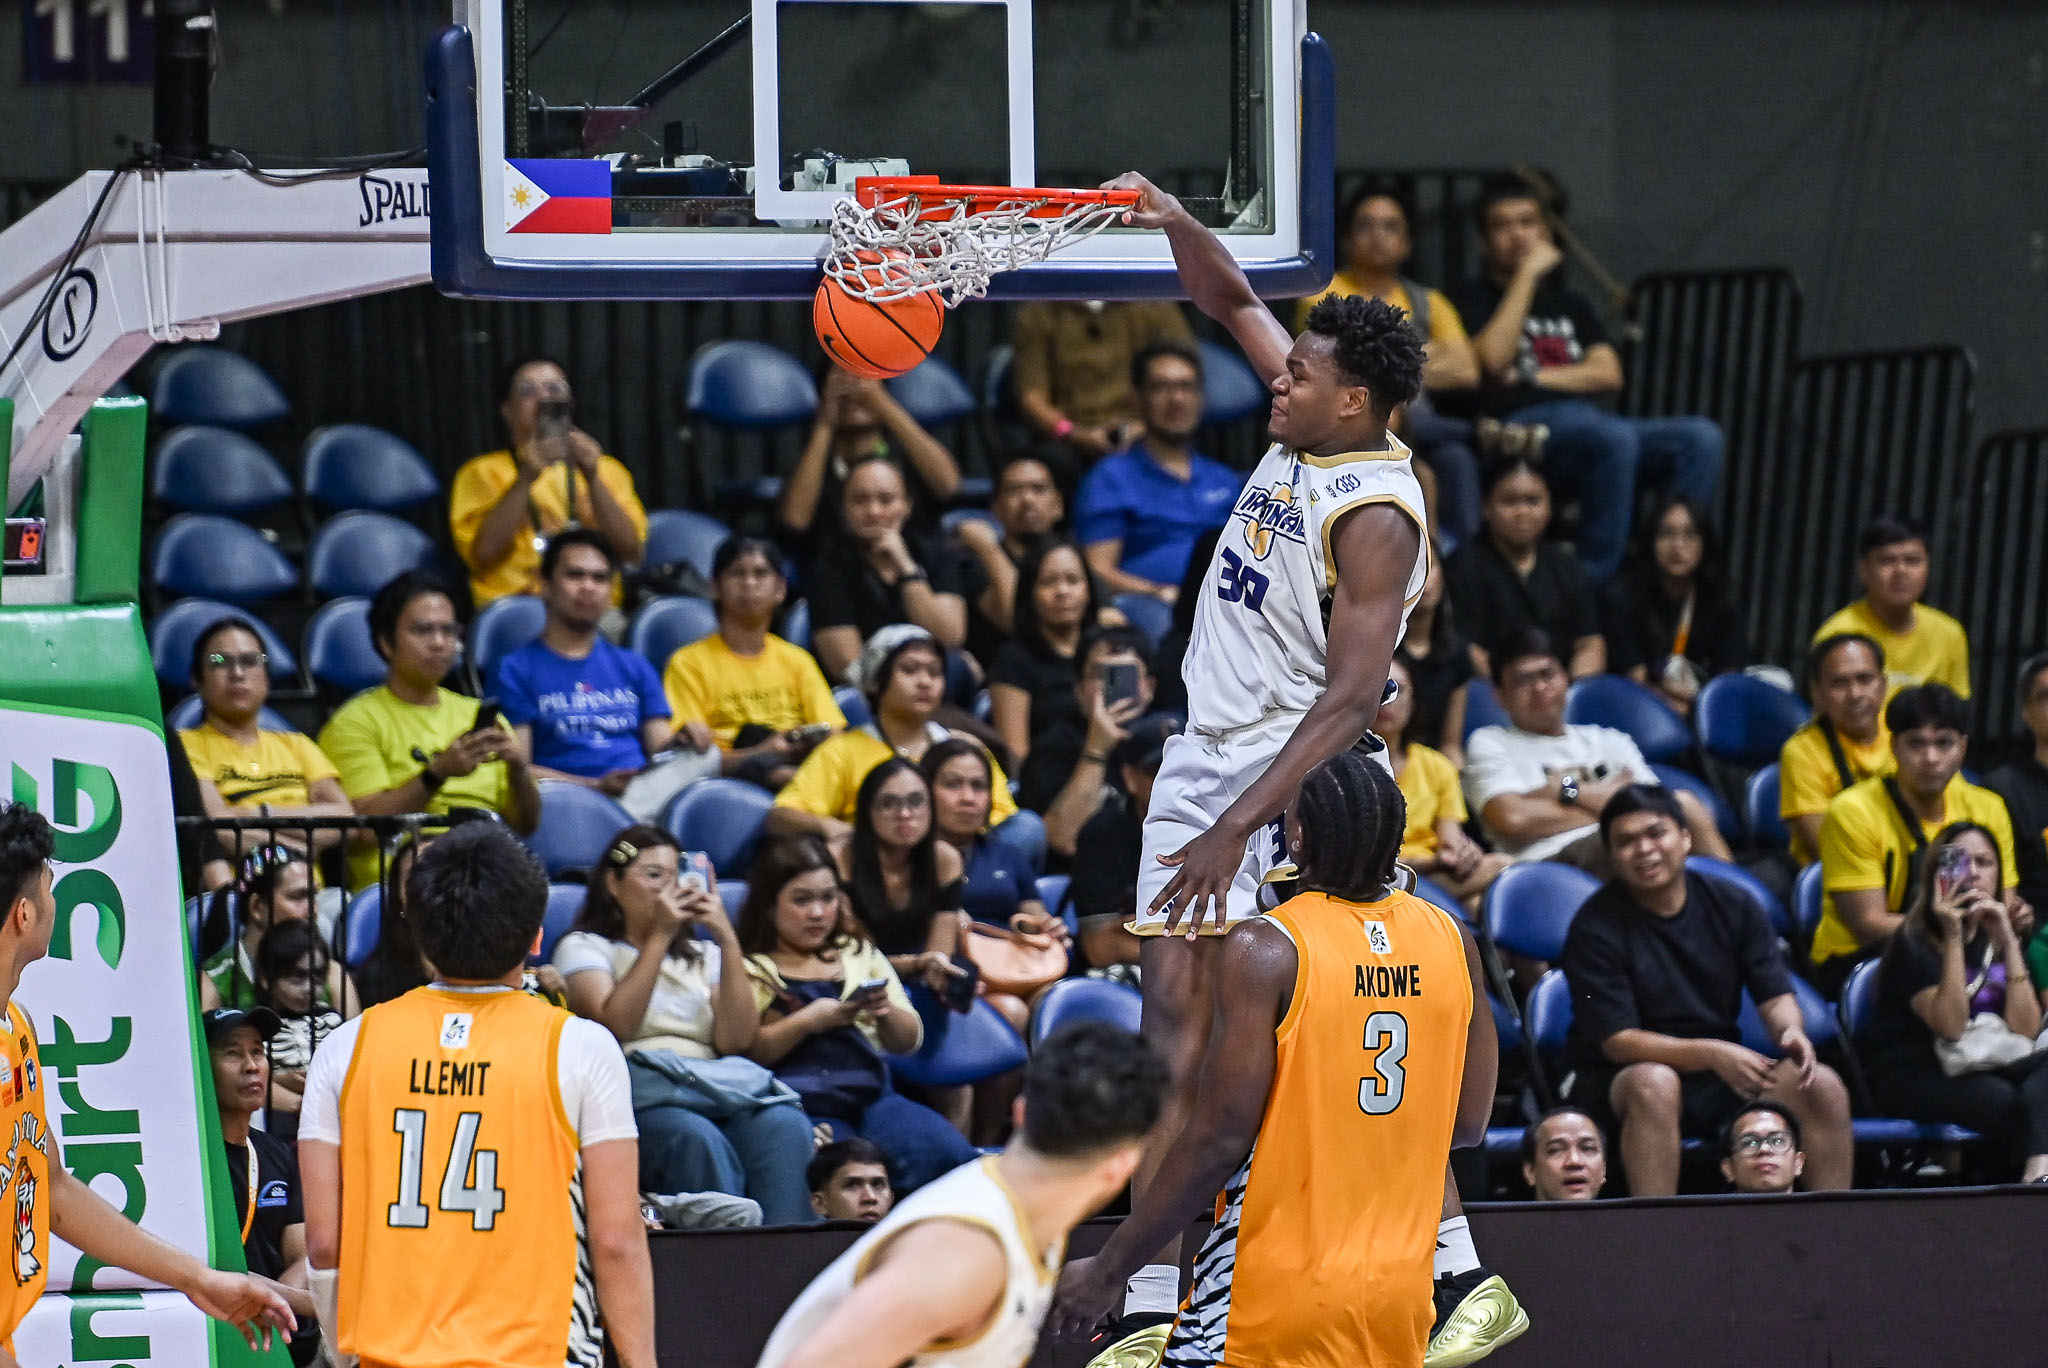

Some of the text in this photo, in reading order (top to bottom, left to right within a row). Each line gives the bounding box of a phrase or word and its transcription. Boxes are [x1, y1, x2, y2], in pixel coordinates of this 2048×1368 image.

[1218, 546, 1269, 615] 30
[1354, 964, 1421, 998] AKOWE
[409, 1058, 491, 1096] LLEMIT
[1358, 1011, 1408, 1115] 3
[38, 1014, 151, 1368] mart
[387, 1107, 505, 1231] 14
